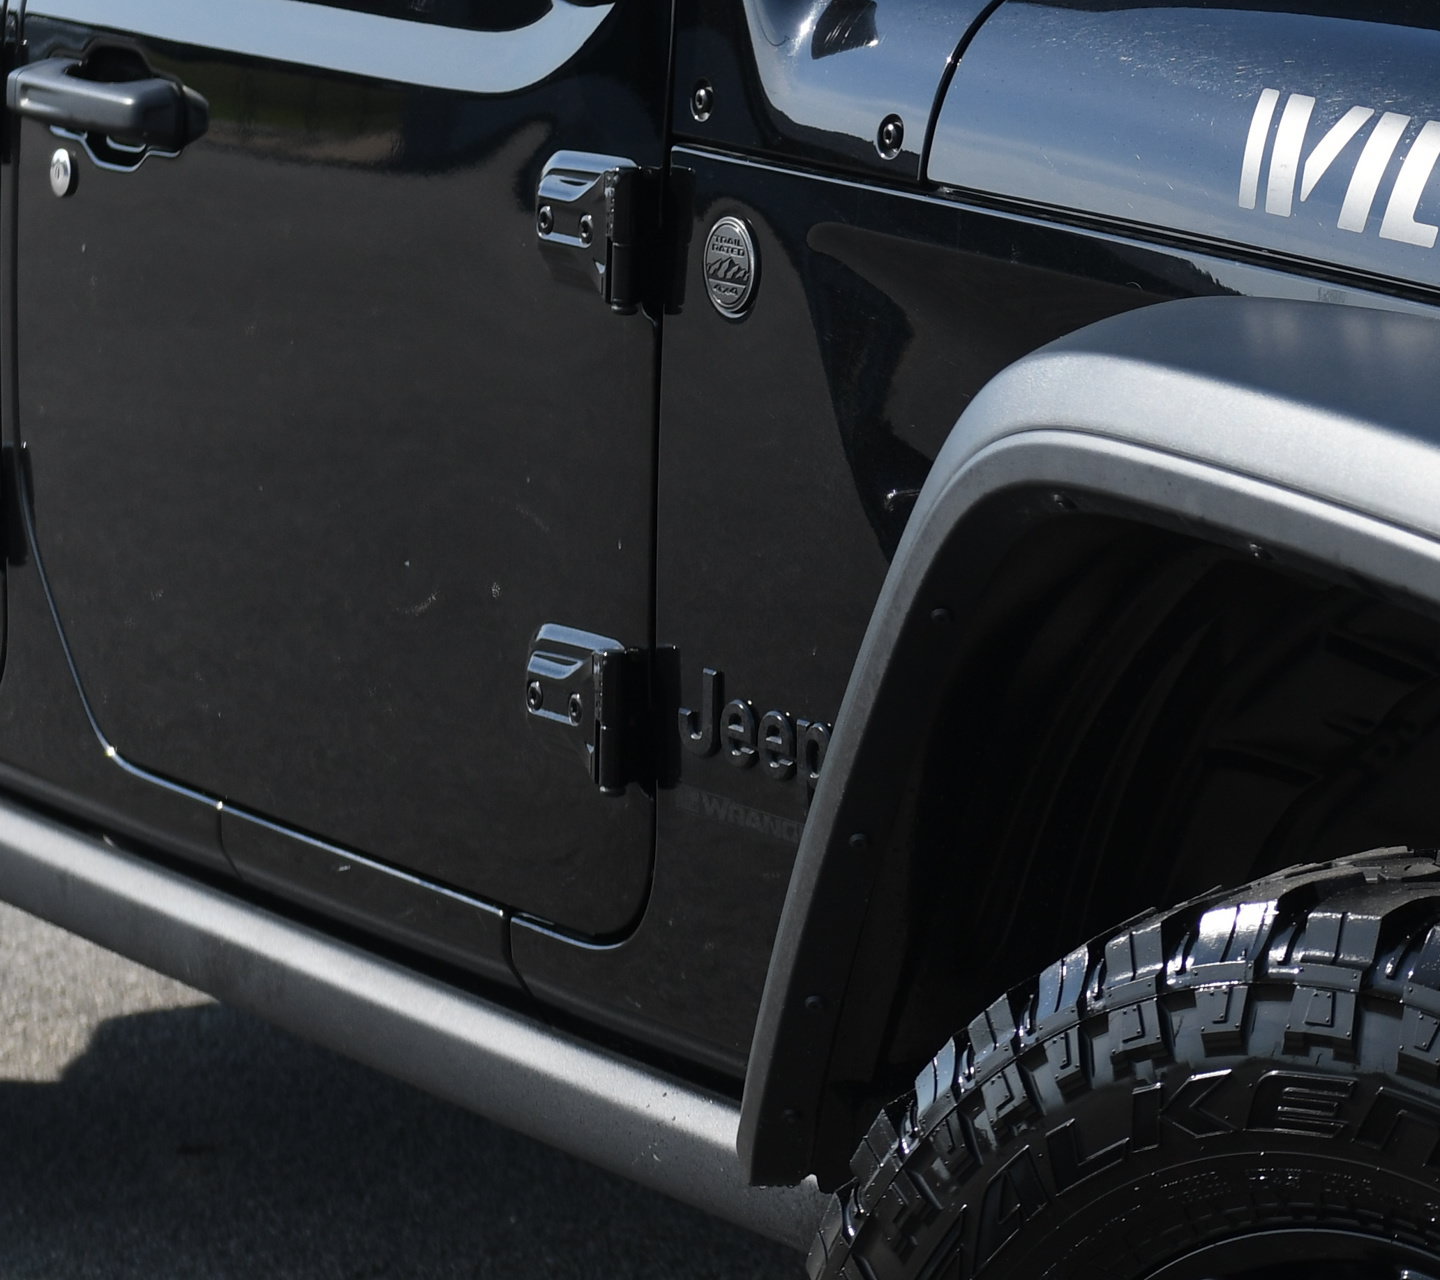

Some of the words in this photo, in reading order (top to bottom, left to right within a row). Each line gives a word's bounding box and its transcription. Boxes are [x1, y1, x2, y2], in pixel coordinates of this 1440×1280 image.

[714, 235, 744, 247] TRAIL
[712, 243, 745, 256] RATED
[678, 667, 831, 816] Jeep
